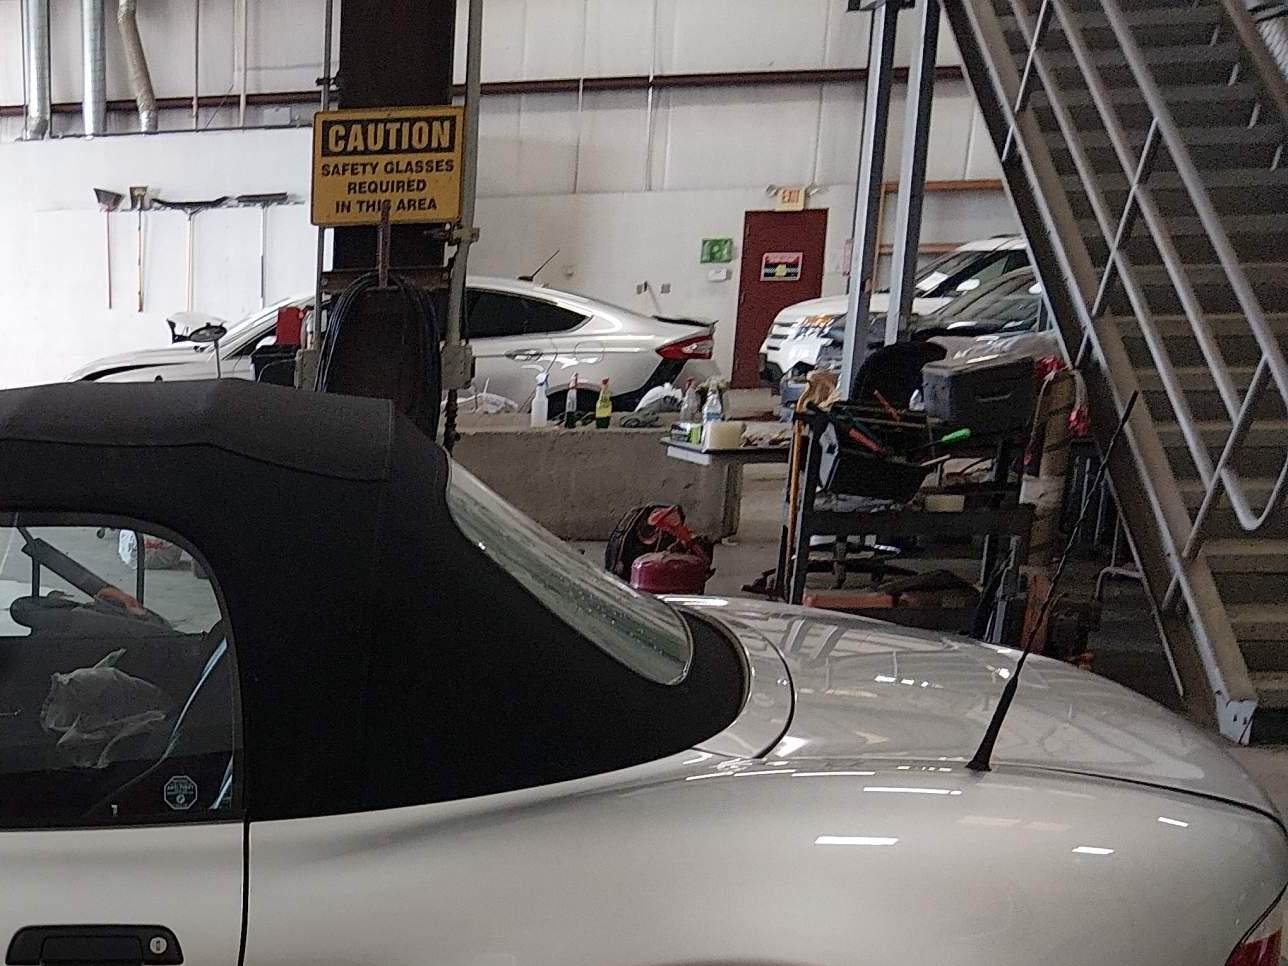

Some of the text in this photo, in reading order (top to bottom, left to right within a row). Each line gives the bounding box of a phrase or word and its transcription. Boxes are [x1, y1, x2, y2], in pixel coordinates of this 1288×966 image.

[328, 120, 451, 153] CAUTION
[321, 159, 454, 176] SAFETY GLASSES
[347, 179, 427, 195] REQUIRED
[335, 201, 351, 214] IN
[396, 198, 437, 212] AREA
